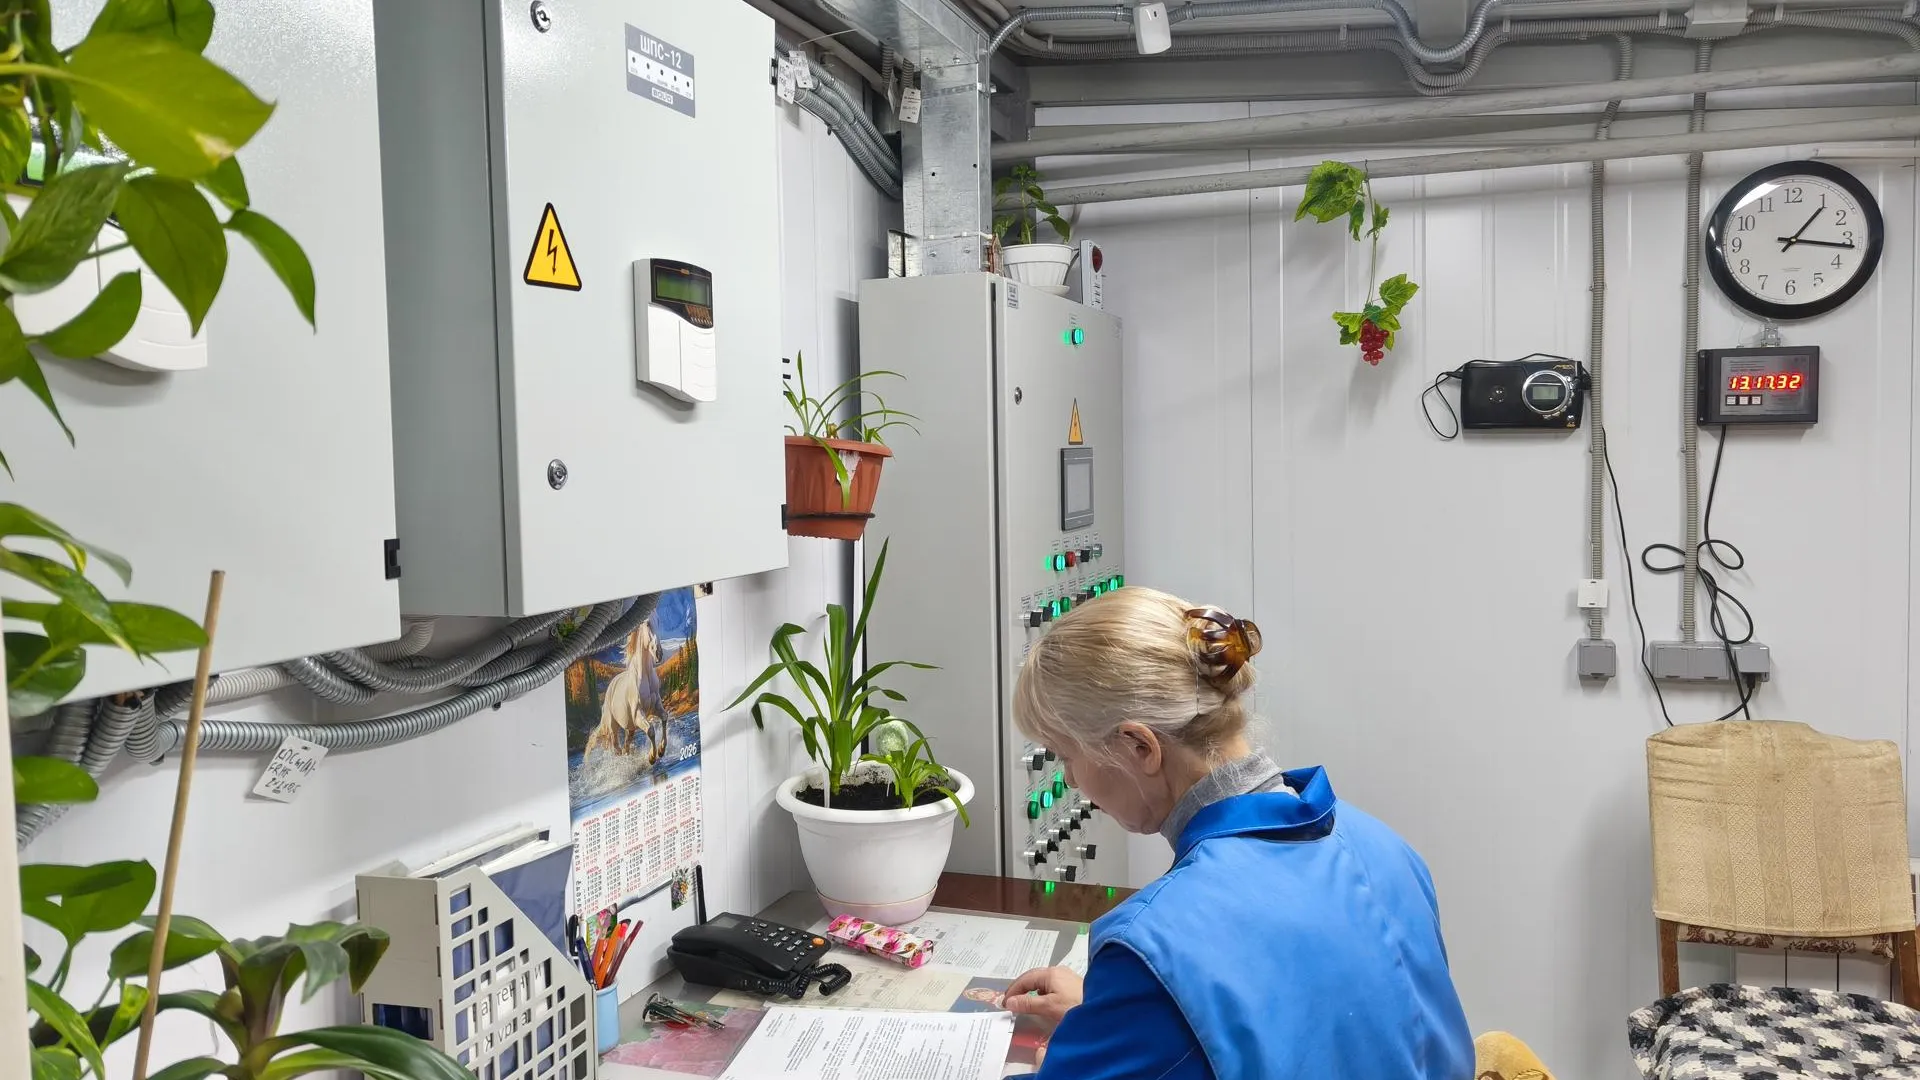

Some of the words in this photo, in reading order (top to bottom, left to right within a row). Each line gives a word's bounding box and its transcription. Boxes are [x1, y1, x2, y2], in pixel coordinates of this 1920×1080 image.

[640, 34, 682, 69] ШПС-12
[1783, 187, 1803, 204] 12
[1819, 193, 1828, 209] 1
[1758, 196, 1774, 213] 11
[1738, 215, 1756, 231] 10
[1835, 209, 1847, 226] 2
[1731, 237, 1742, 253] 9
[1842, 231, 1854, 245] 3
[1739, 258, 1751, 274] 8
[1831, 254, 1843, 269] 4
[1757, 274, 1769, 290] 7
[1785, 279, 1796, 296] 6
[1813, 272, 1825, 287] 5
[679, 743, 697, 761] 2026
